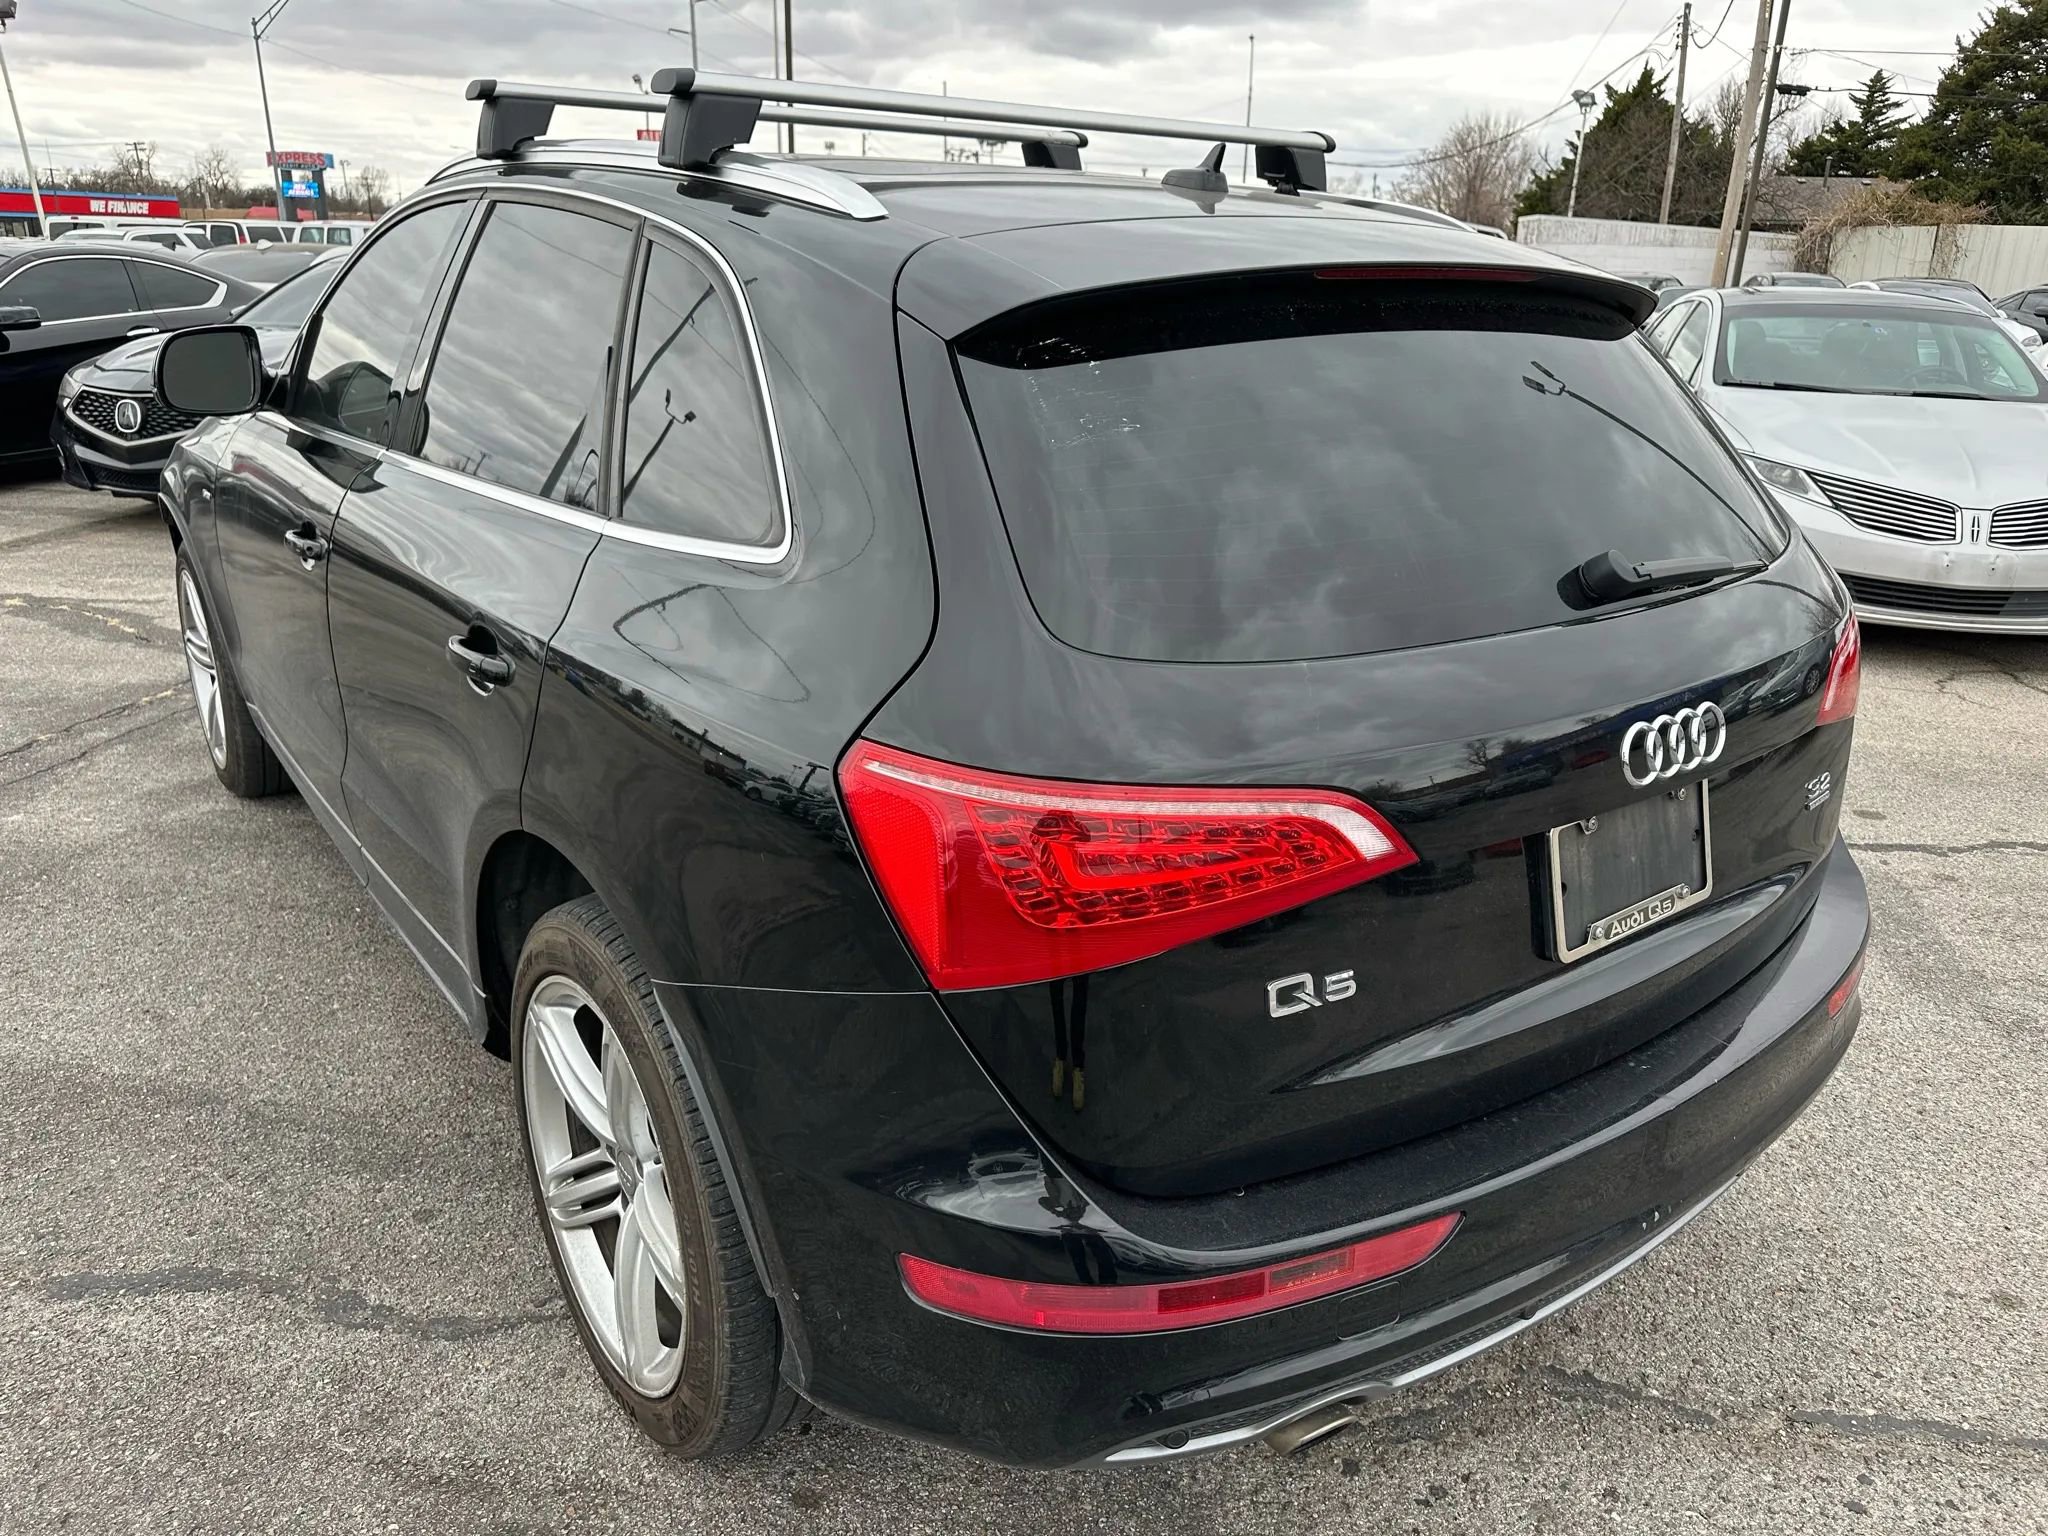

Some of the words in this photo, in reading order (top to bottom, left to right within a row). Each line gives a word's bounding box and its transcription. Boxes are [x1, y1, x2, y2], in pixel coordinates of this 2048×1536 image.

[90, 199, 107, 213] WE
[107, 200, 150, 215] FINANCE
[1609, 910, 1645, 939] Audi
[1648, 899, 1673, 920] Q5
[1266, 969, 1357, 1018] Q5
